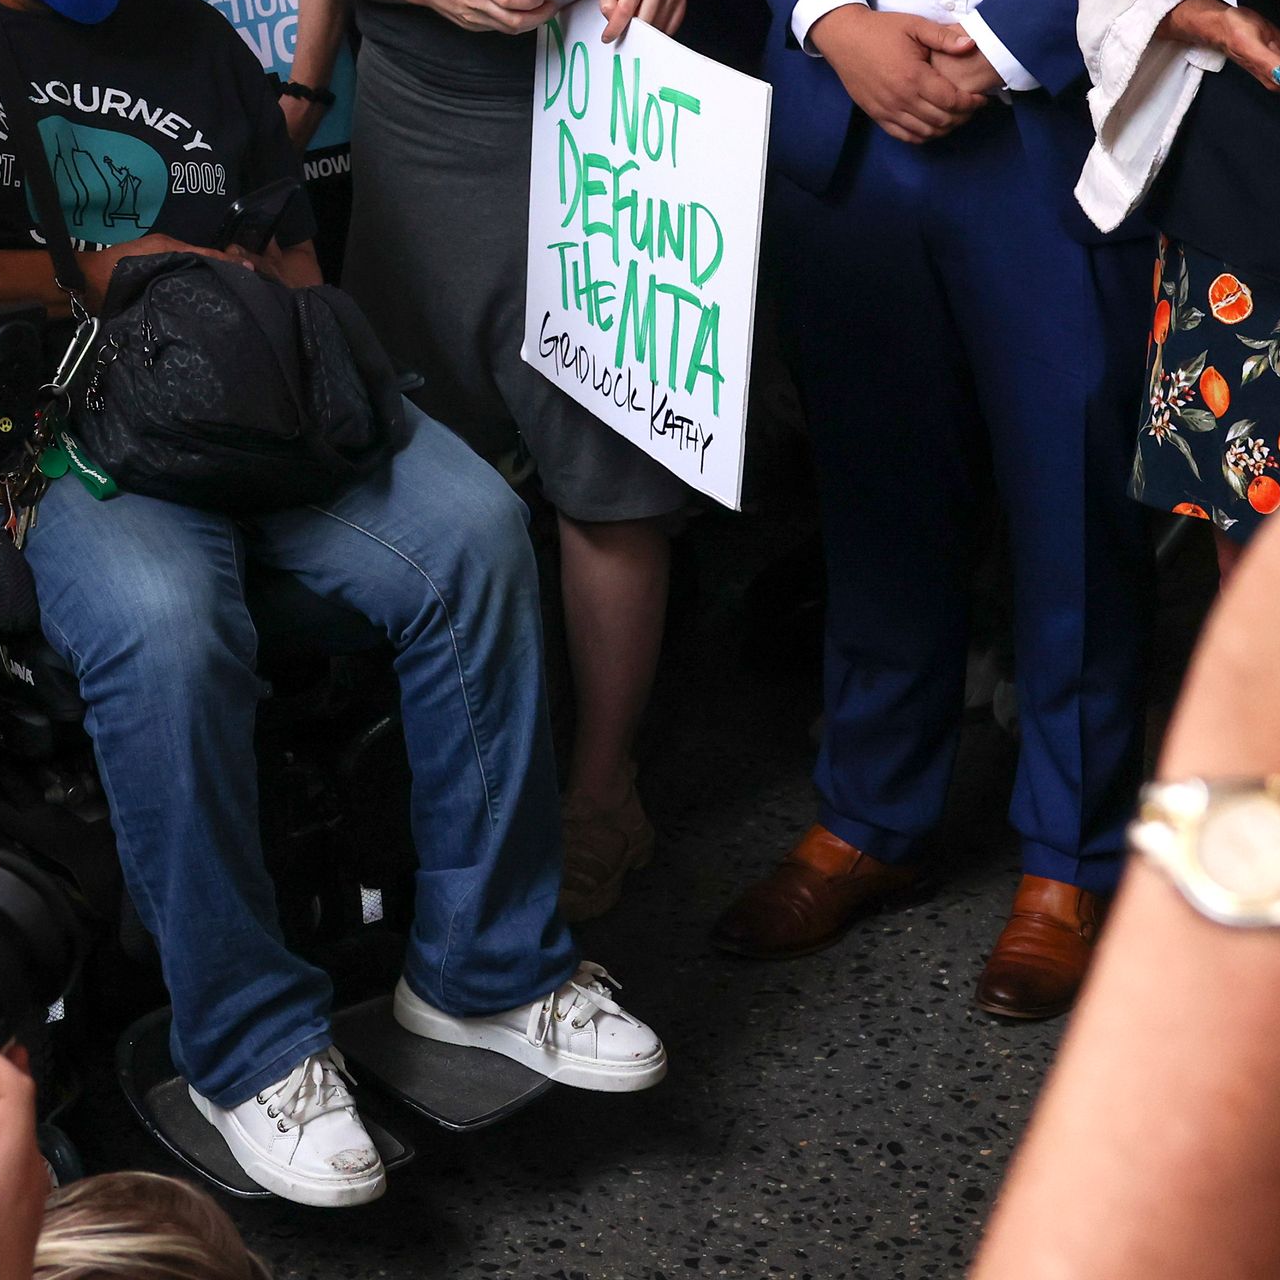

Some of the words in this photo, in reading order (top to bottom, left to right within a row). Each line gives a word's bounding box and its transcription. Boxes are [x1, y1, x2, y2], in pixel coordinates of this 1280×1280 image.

[28, 80, 212, 152] JOURNEY
[304, 153, 351, 181] NOW
[542, 20, 588, 119] DO
[610, 53, 701, 167] NOT
[170, 161, 226, 195] 2002
[558, 120, 724, 288] DEFUND
[539, 311, 645, 416] GRIDLOCK
[649, 382, 713, 473] KATHY
[548, 240, 616, 331] THE
[614, 260, 725, 416] MTA
